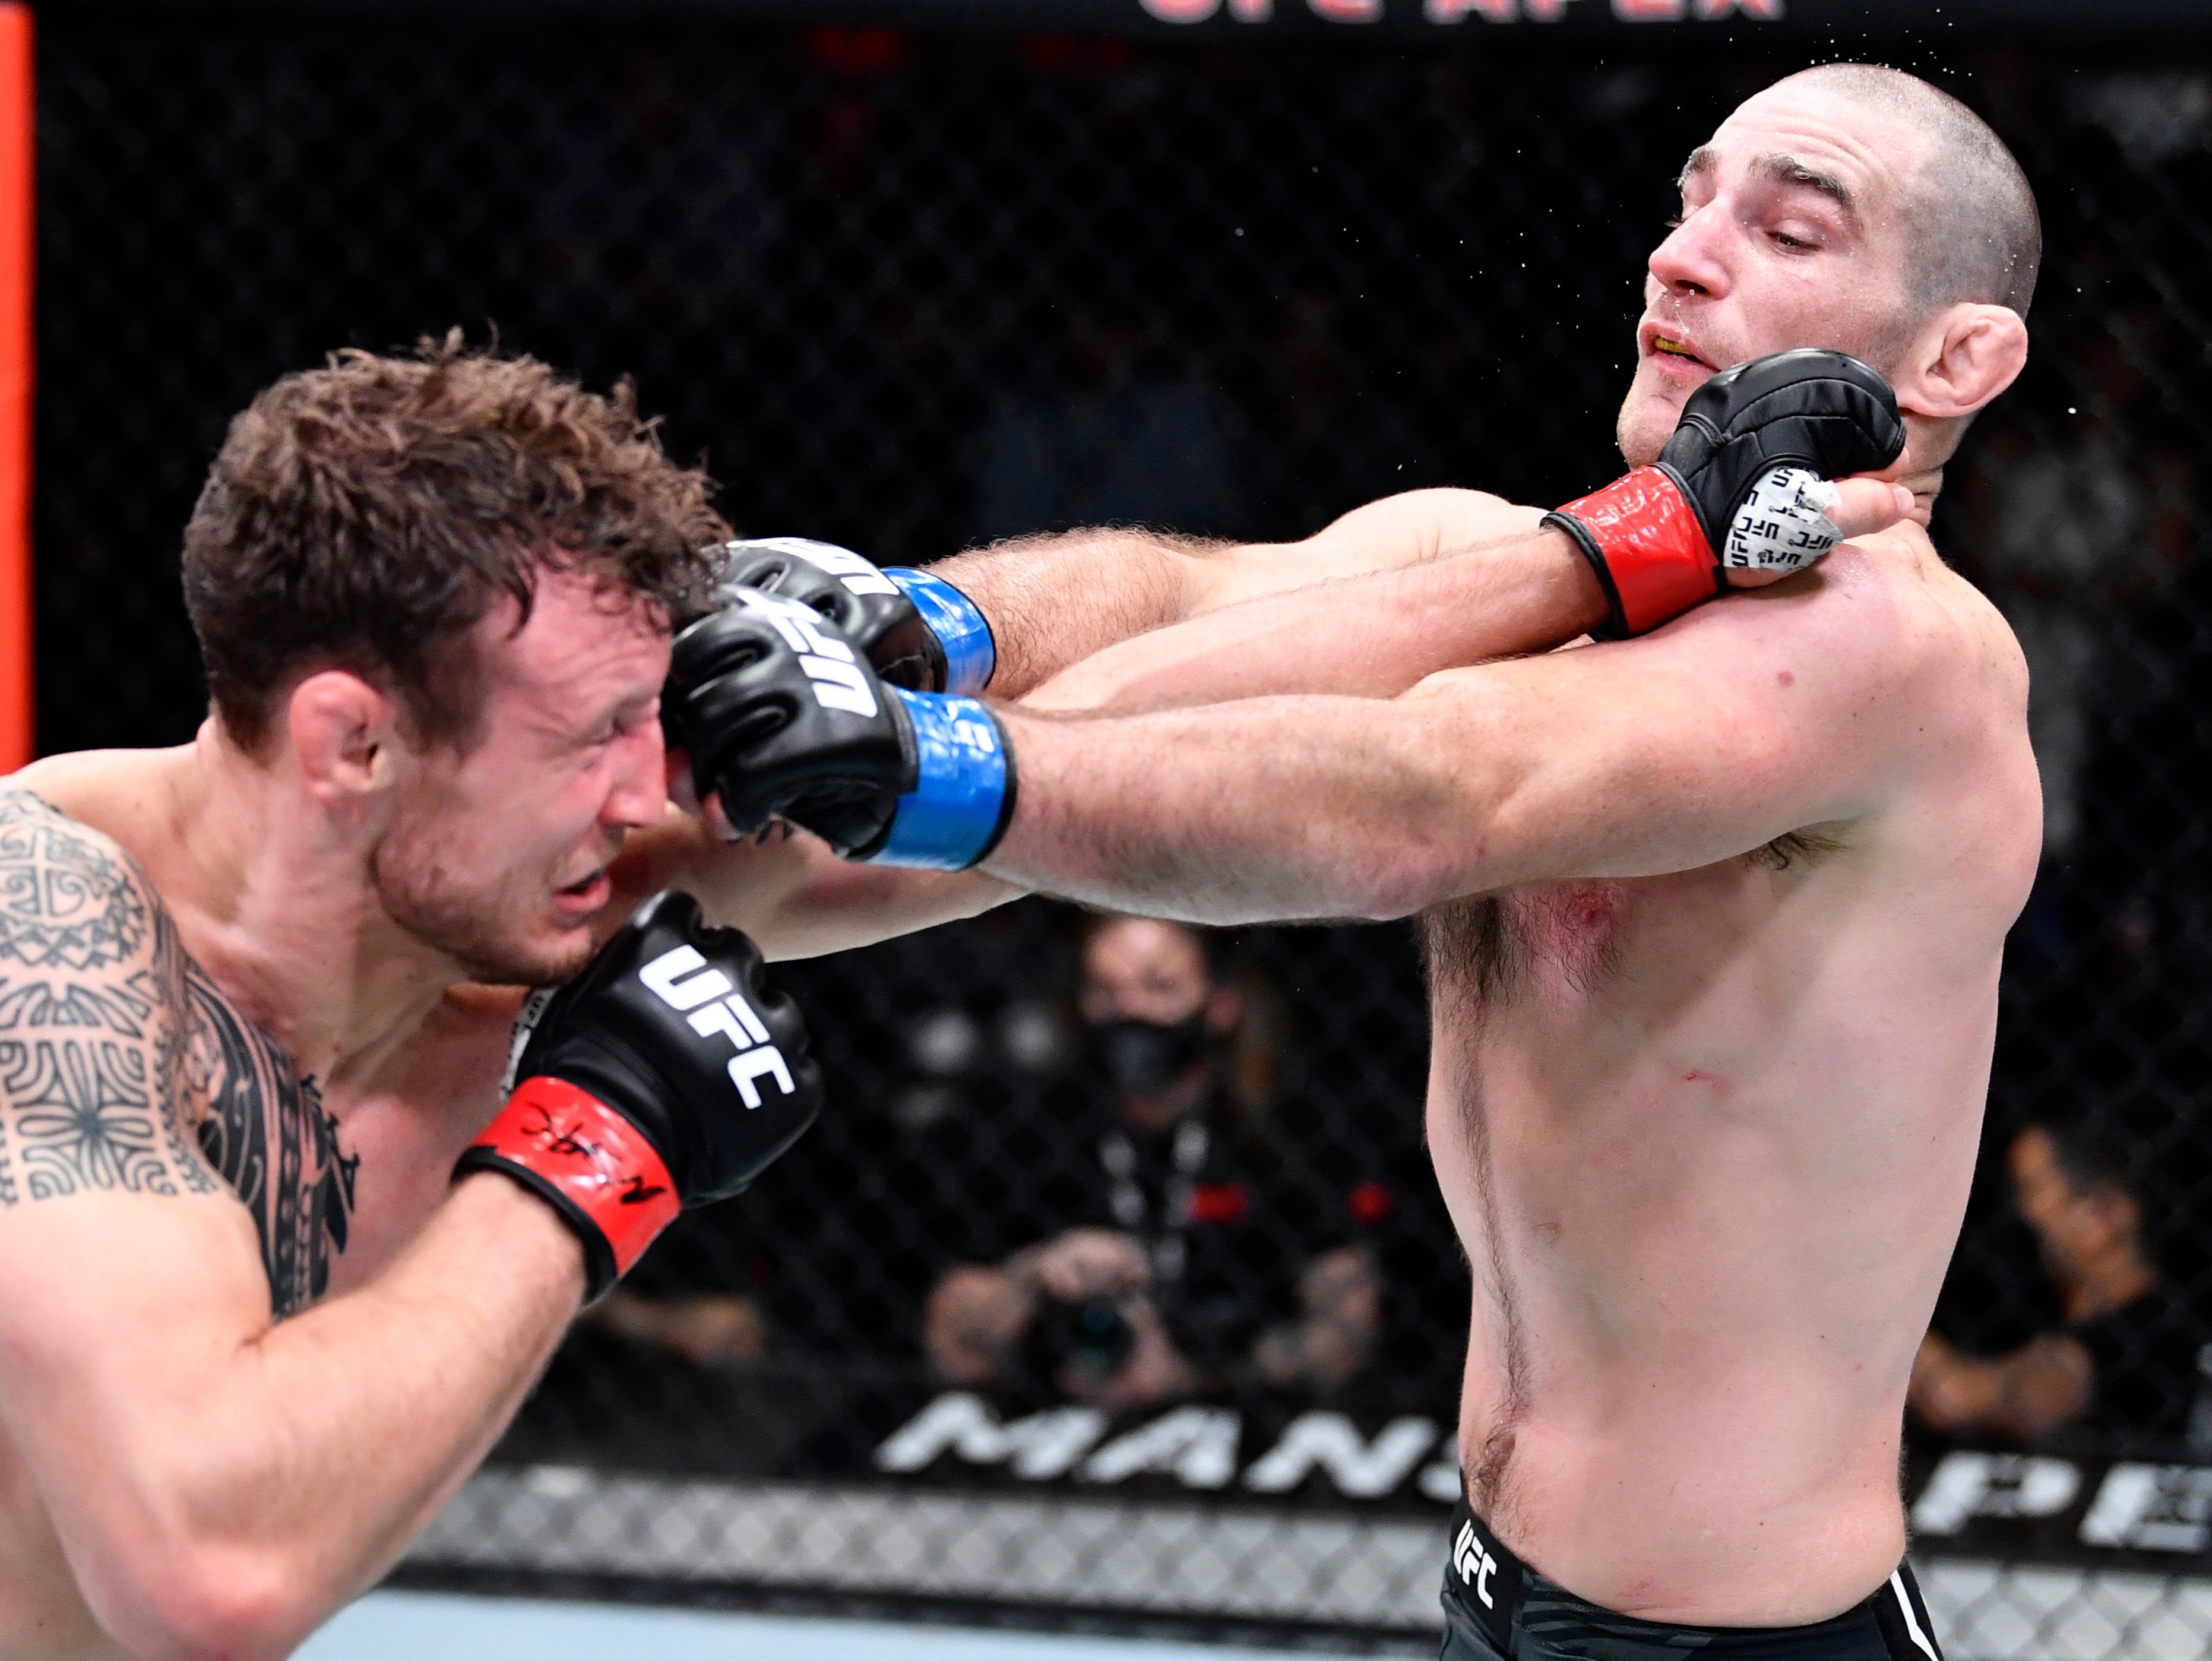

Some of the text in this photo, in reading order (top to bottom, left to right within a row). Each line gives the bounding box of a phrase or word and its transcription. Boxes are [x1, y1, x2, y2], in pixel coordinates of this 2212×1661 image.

[1737, 516, 1780, 540] UFC
[638, 944, 796, 1109] UFC
[1454, 1518, 1497, 1609] UFC
